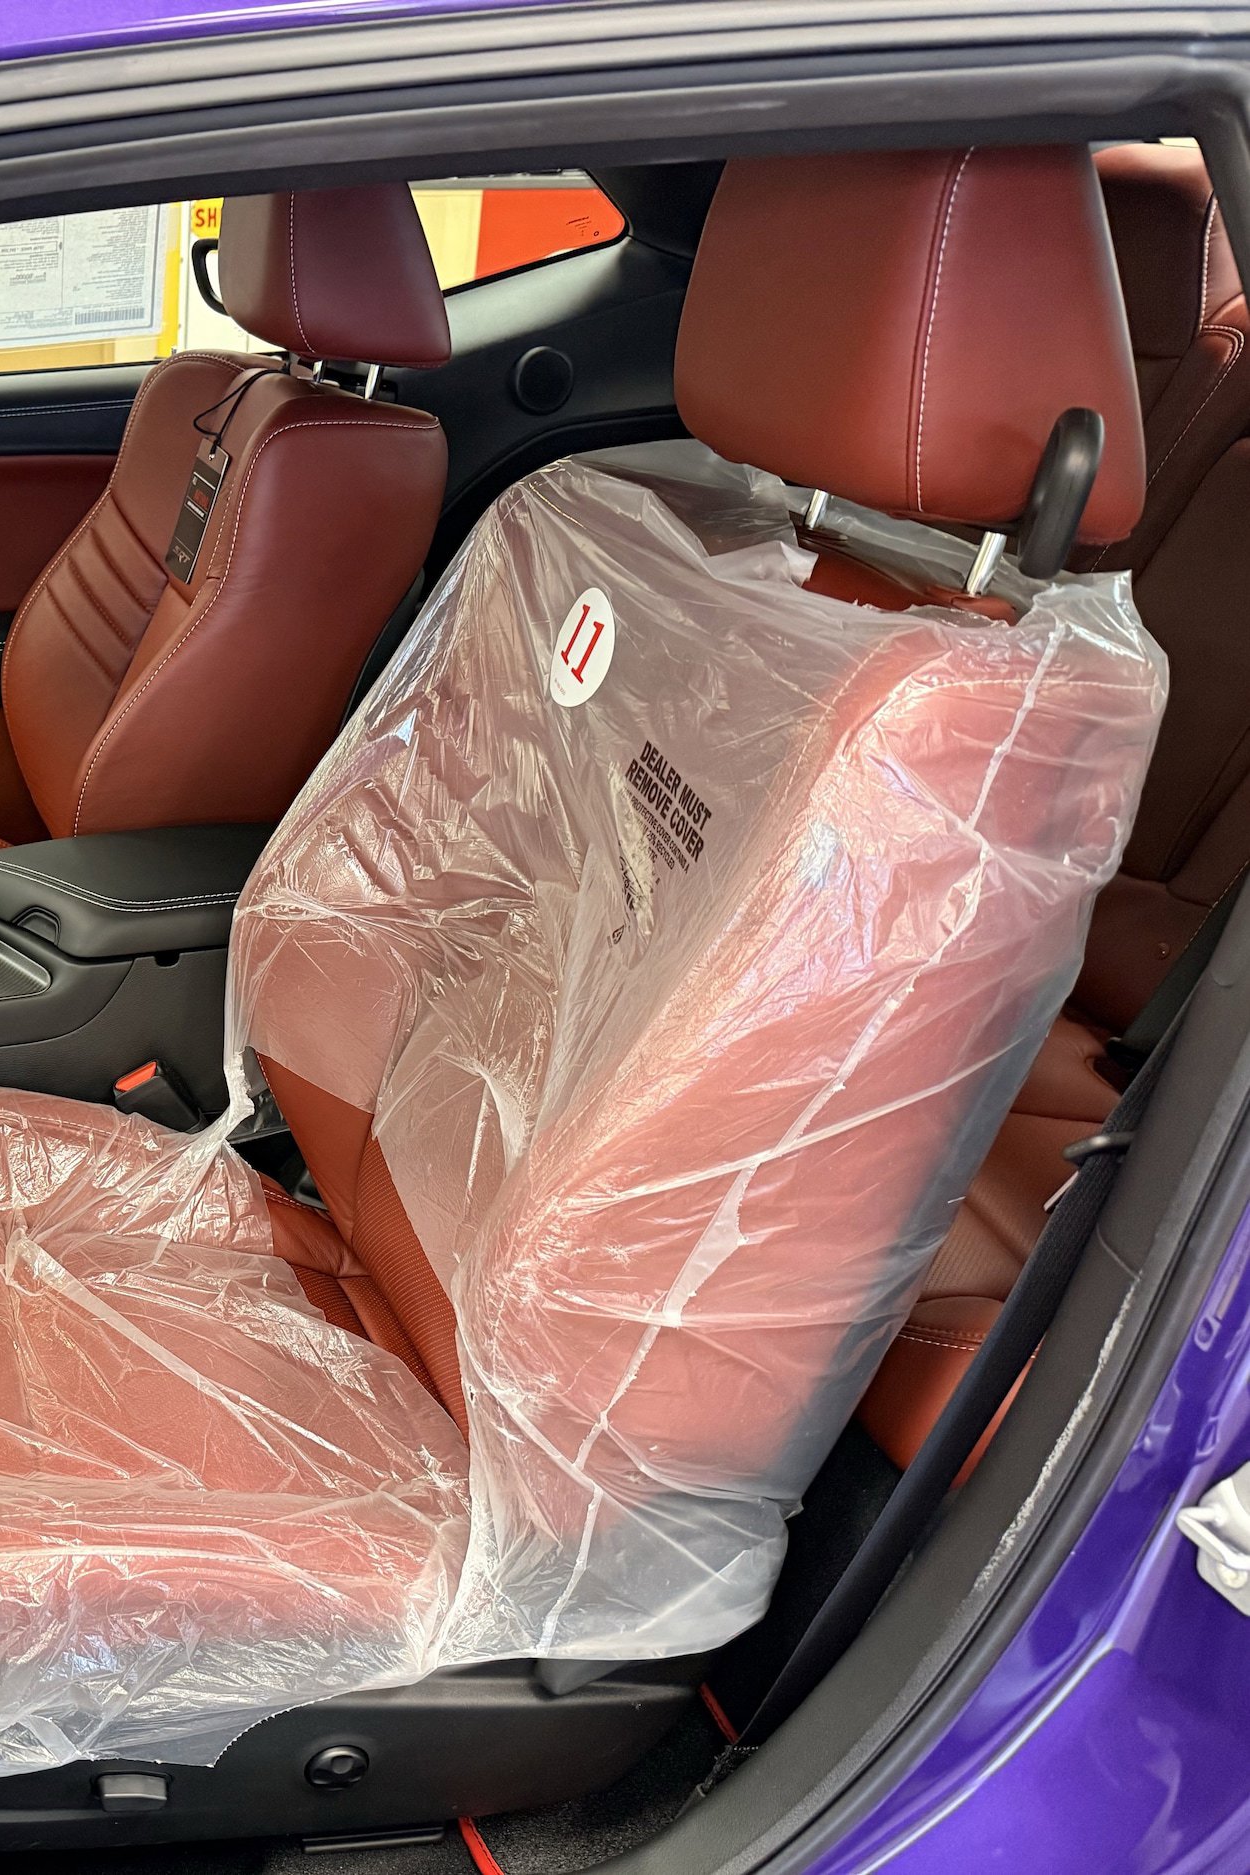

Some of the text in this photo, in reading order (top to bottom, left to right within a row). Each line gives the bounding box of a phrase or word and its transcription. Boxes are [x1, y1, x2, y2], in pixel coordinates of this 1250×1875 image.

[560, 603, 605, 684] 11
[625, 758, 672, 820] REMOVE
[670, 807, 704, 863] COVER
[631, 796, 658, 829] PROTECTIVE
[656, 823, 671, 847] COVER
[639, 740, 712, 831] DEALER MUST
